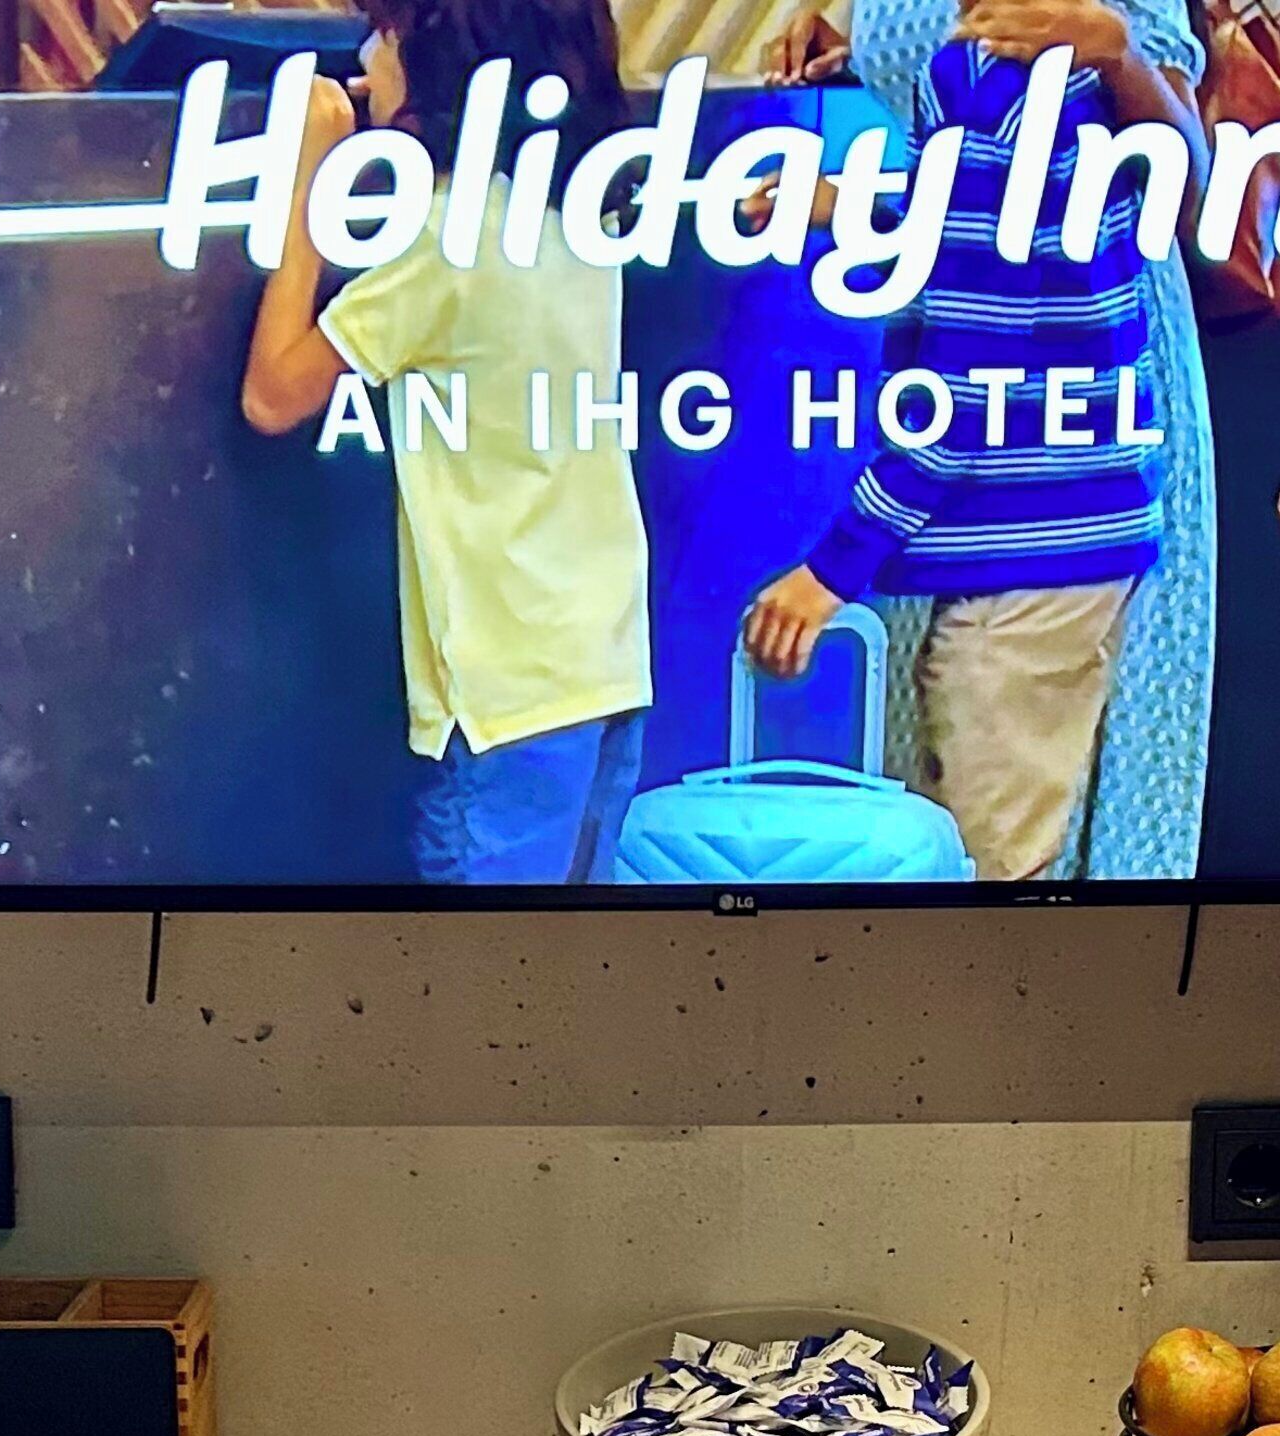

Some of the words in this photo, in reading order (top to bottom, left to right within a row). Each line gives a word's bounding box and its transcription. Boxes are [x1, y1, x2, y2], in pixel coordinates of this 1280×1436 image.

[159, 51, 965, 320] Holiday
[317, 373, 468, 453] AN
[530, 371, 733, 452] IHG
[793, 368, 1165, 450] HOTEL
[736, 896, 754, 909] LG
